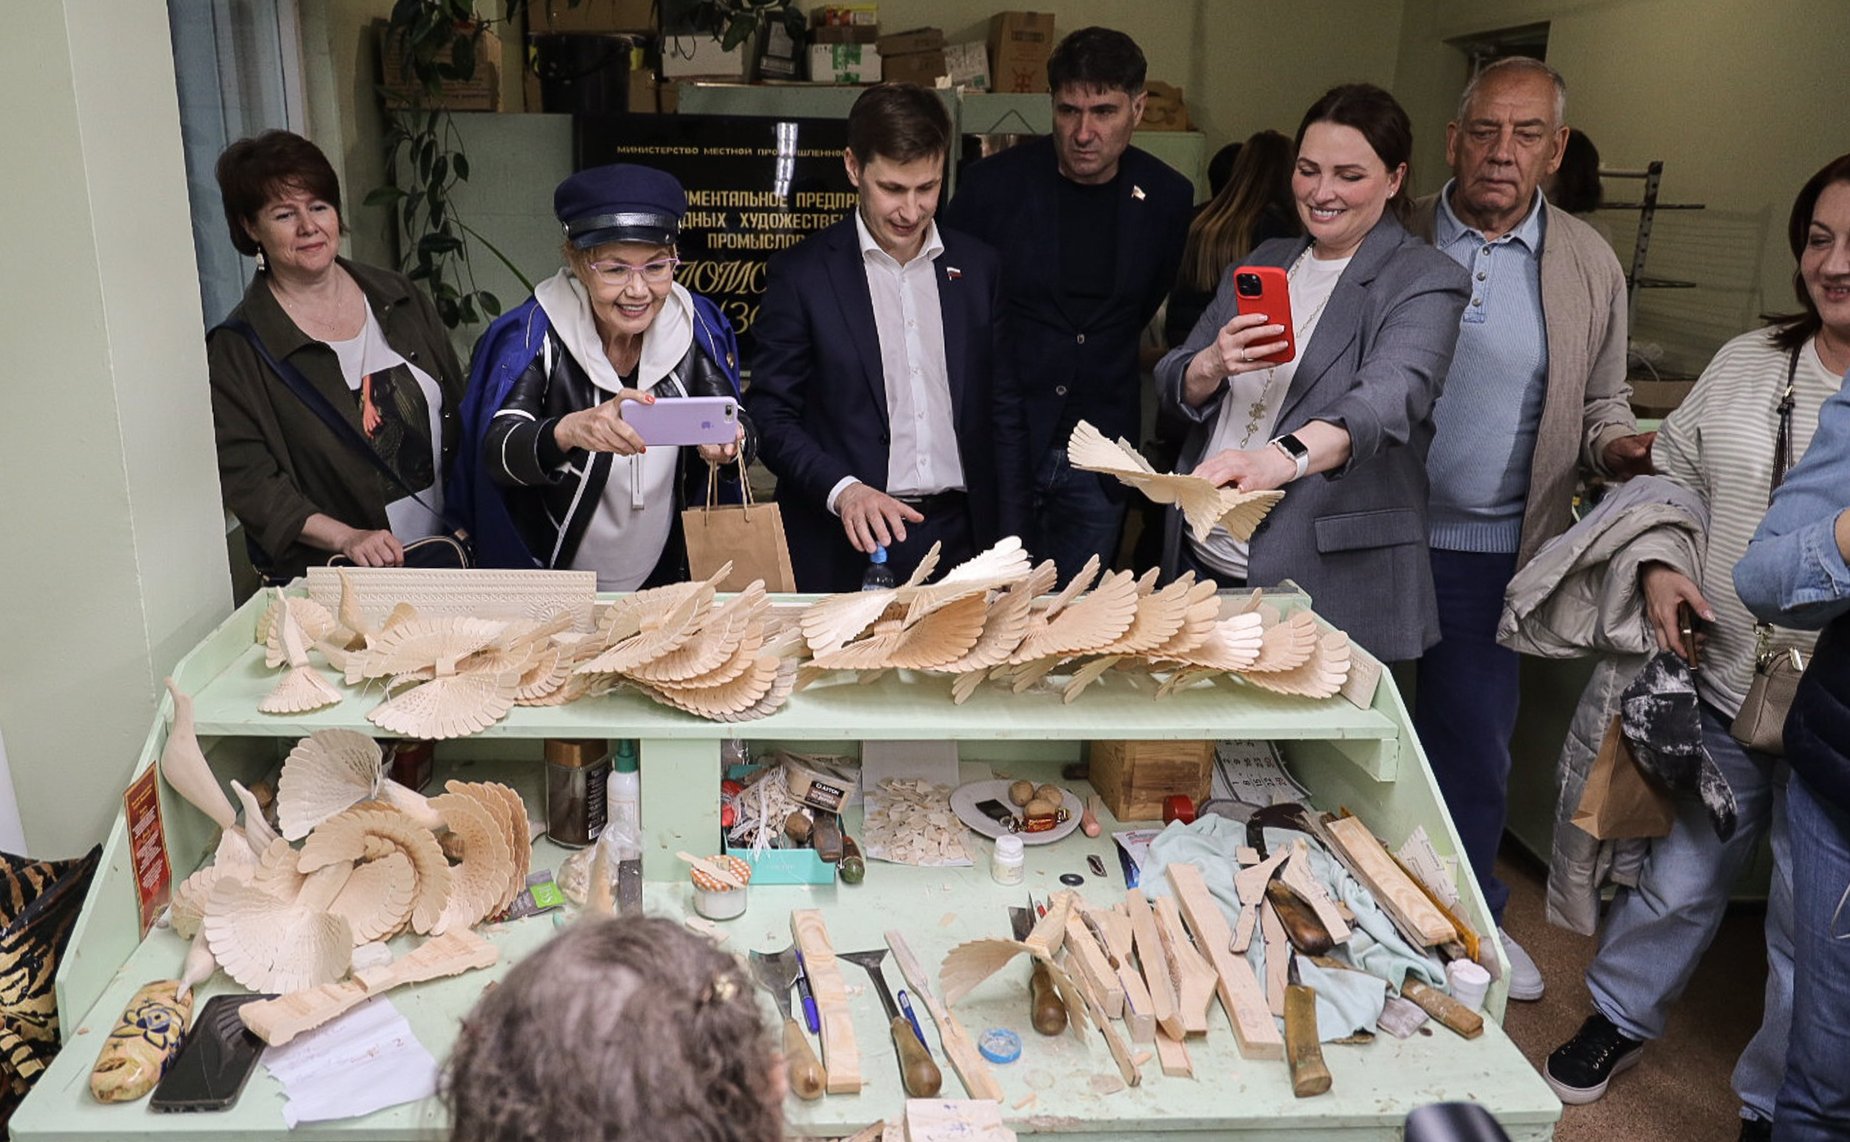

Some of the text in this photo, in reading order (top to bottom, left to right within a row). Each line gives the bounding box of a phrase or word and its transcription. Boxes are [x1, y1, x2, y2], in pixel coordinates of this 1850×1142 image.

[617, 145, 699, 155] МИНИСТЕРСТВО
[682, 211, 844, 231] ДНЫХ ХУДОЖЕСТВЕ
